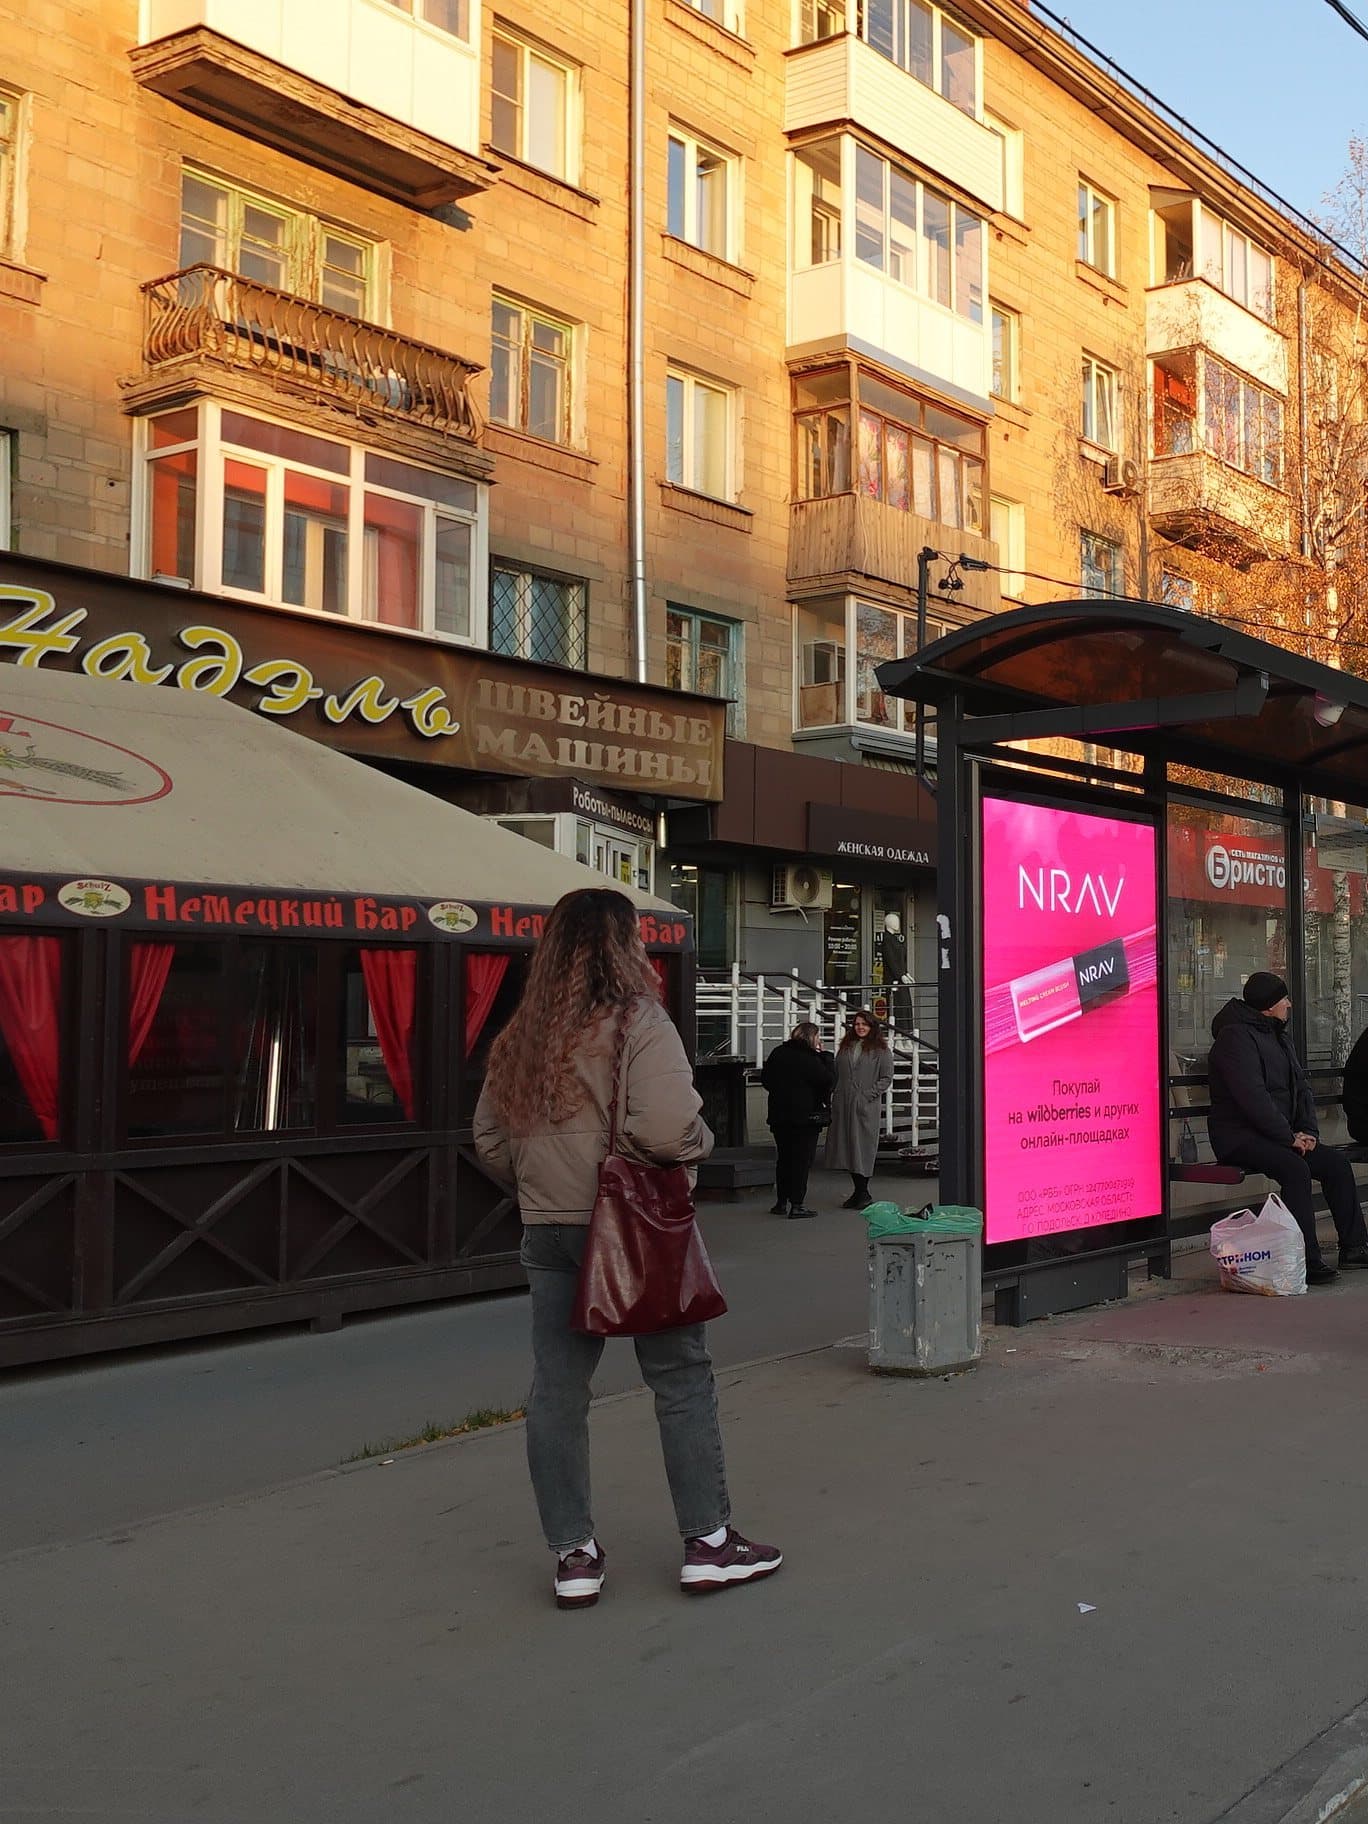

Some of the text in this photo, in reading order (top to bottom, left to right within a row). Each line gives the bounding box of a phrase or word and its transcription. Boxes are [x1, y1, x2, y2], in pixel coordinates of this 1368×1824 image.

[477, 678, 713, 747] ШВЕЙНЫЕ
[477, 725, 712, 786] МАШИНЫ
[572, 786, 655, 834] Роботы-пылесосы
[837, 841, 930, 864] ЖЕНСКАЯ ОДЕЖДА
[0, 884, 45, 914] ар
[1018, 863, 1124, 918] NRAV
[144, 884, 418, 932] Немецкий Бар
[640, 914, 687, 945] Бар
[1079, 957, 1114, 986] NRAV
[1052, 1078, 1101, 1098] Покупай
[1008, 1102, 1140, 1125] на wildberries и других
[1020, 1127, 1130, 1149] онлайн-площадках
